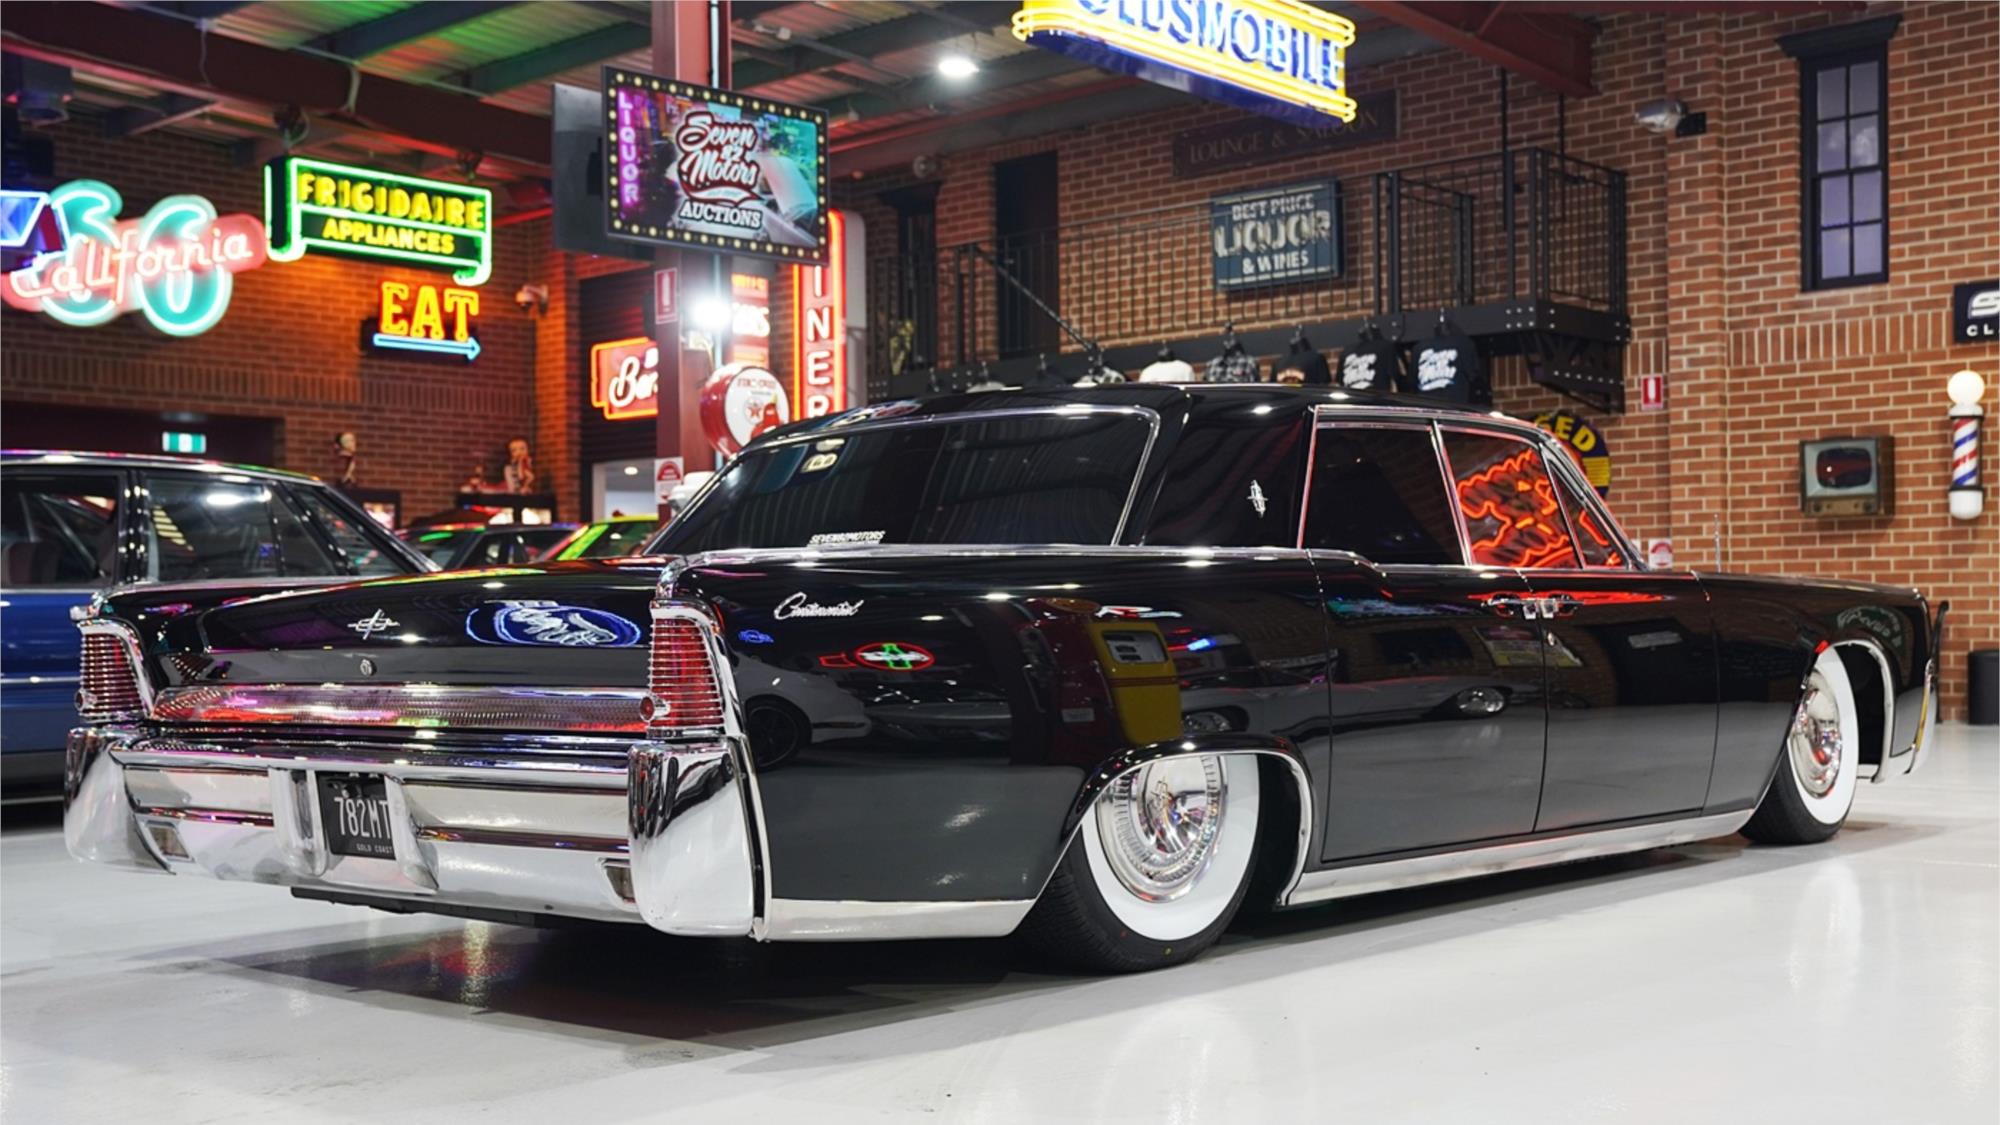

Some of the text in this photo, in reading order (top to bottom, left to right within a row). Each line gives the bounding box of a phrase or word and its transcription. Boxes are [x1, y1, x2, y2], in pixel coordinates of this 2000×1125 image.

[1077, 0, 1346, 91] LDSMOBILE
[618, 89, 640, 205] LIQUOR
[678, 113, 756, 153] Seven
[1189, 131, 1264, 165] LOUNGE
[1271, 128, 1288, 149] &
[680, 148, 758, 186] Motors
[297, 172, 485, 230] FRIGIDAIRE
[679, 201, 762, 228] AUCTIONS
[1232, 193, 1315, 221] BEST PRICE
[321, 217, 456, 255] APPLIANCES
[9, 228, 255, 305] California
[1243, 249, 1309, 275] & WINES
[379, 280, 480, 342] EAT
[806, 265, 832, 418] INER
[773, 591, 864, 620] Continental
